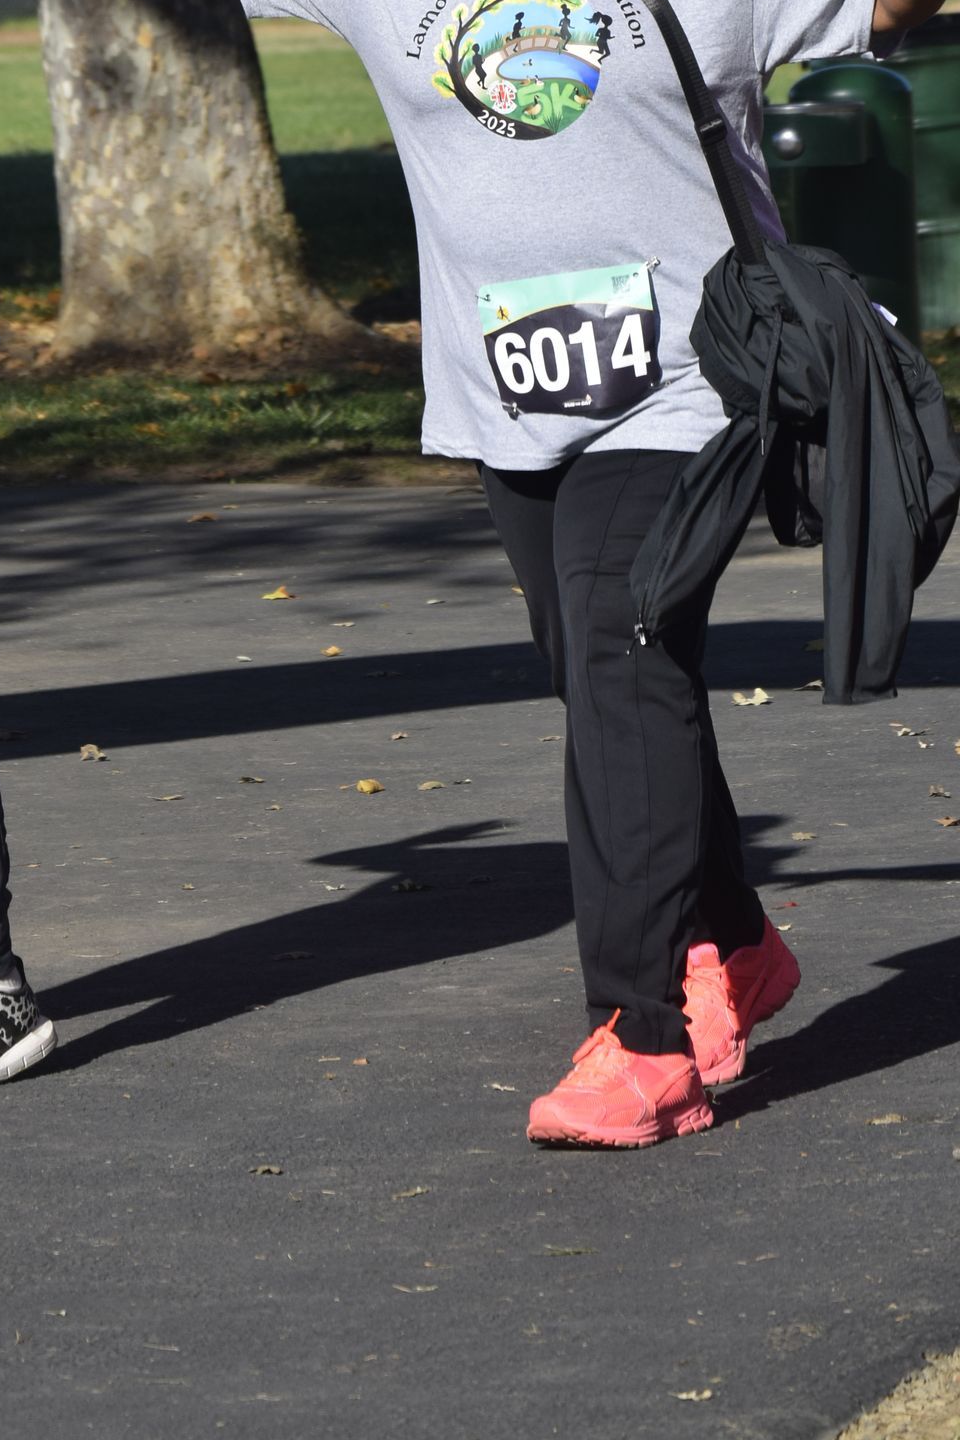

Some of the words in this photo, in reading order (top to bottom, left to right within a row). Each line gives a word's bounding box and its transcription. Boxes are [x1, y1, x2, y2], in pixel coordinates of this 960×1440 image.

[477, 110, 516, 138] 2025
[516, 83, 583, 126] 5K
[494, 314, 651, 394] 6014
